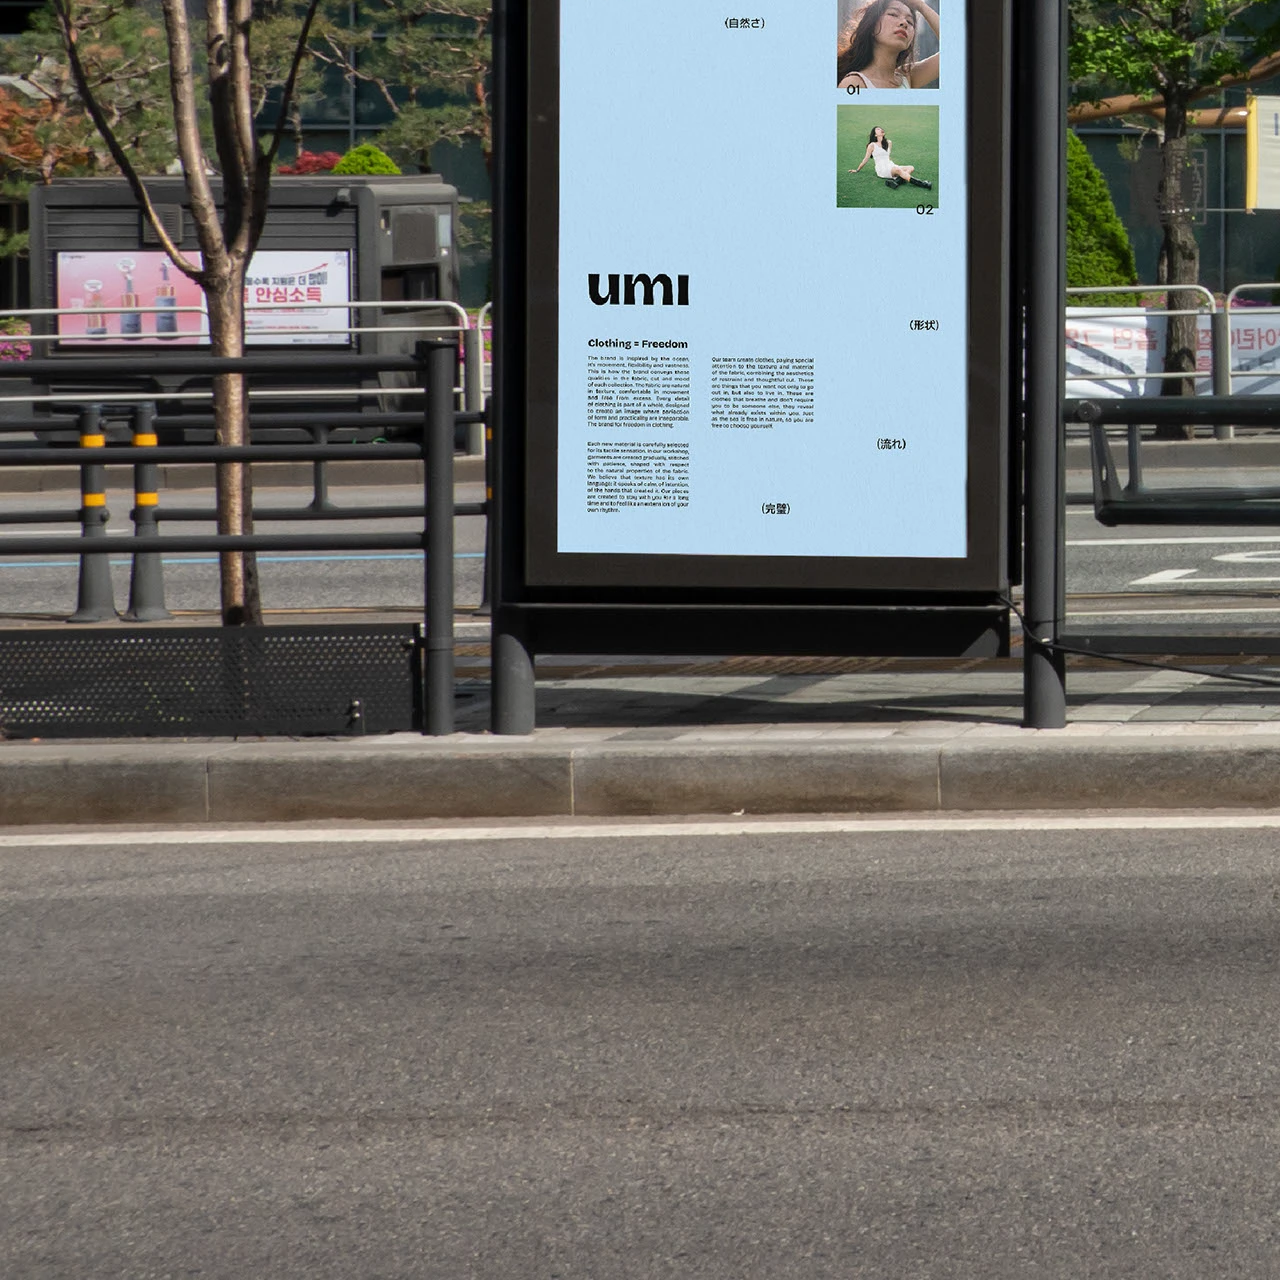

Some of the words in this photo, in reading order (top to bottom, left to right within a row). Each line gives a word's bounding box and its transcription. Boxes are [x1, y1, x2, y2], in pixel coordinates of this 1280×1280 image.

[724, 17, 765, 29] (自然さ)
[846, 84, 860, 95] 01
[915, 203, 934, 215] 02
[255, 286, 322, 303] 안심소득
[587, 273, 690, 306] umi
[909, 319, 939, 331] (形状)
[587, 338, 632, 350] Clothing
[641, 339, 688, 349] Freedom
[876, 438, 906, 450] (流れ)
